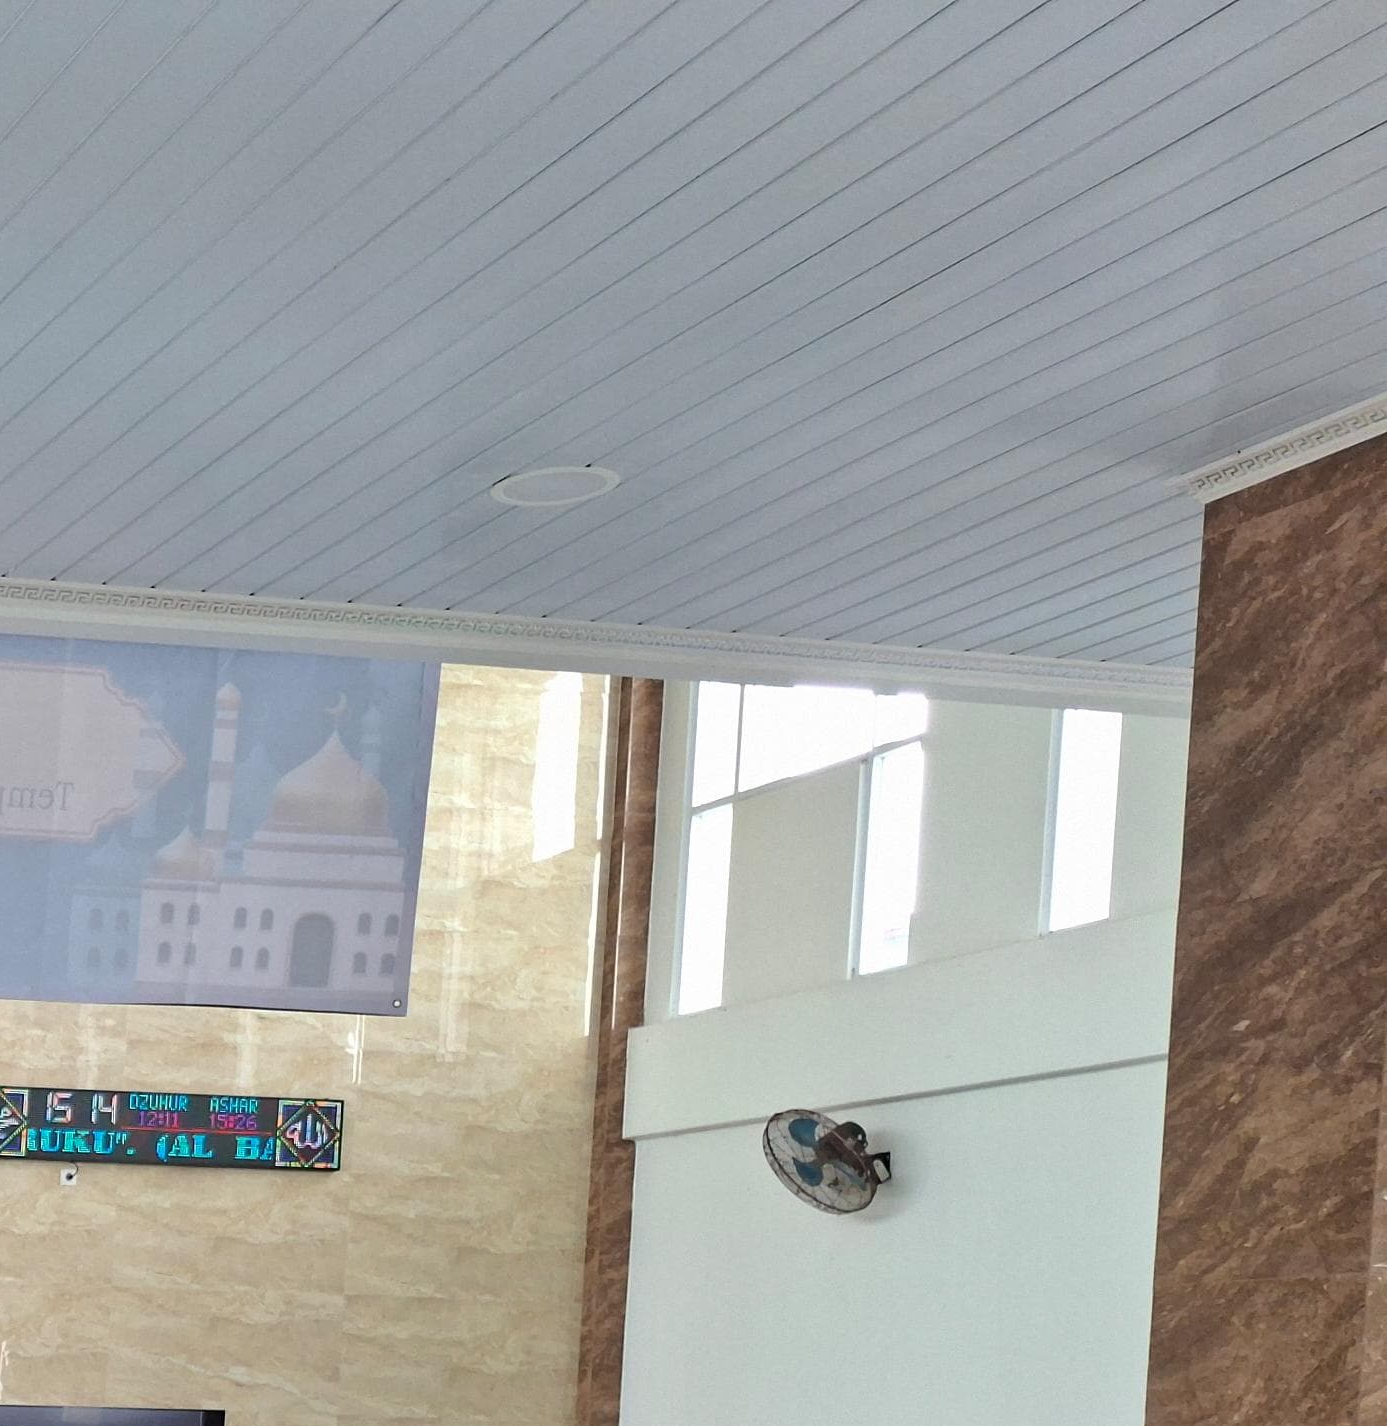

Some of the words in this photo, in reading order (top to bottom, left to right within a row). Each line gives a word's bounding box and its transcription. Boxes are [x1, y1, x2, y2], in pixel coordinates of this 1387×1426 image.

[45, 1091, 73, 1123] 15
[91, 1093, 118, 1125] 14
[210, 1096, 259, 1113] ASHAR
[138, 1110, 180, 1128] 12:11
[209, 1113, 258, 1129] 15:26
[155, 1133, 213, 1162] (AL
